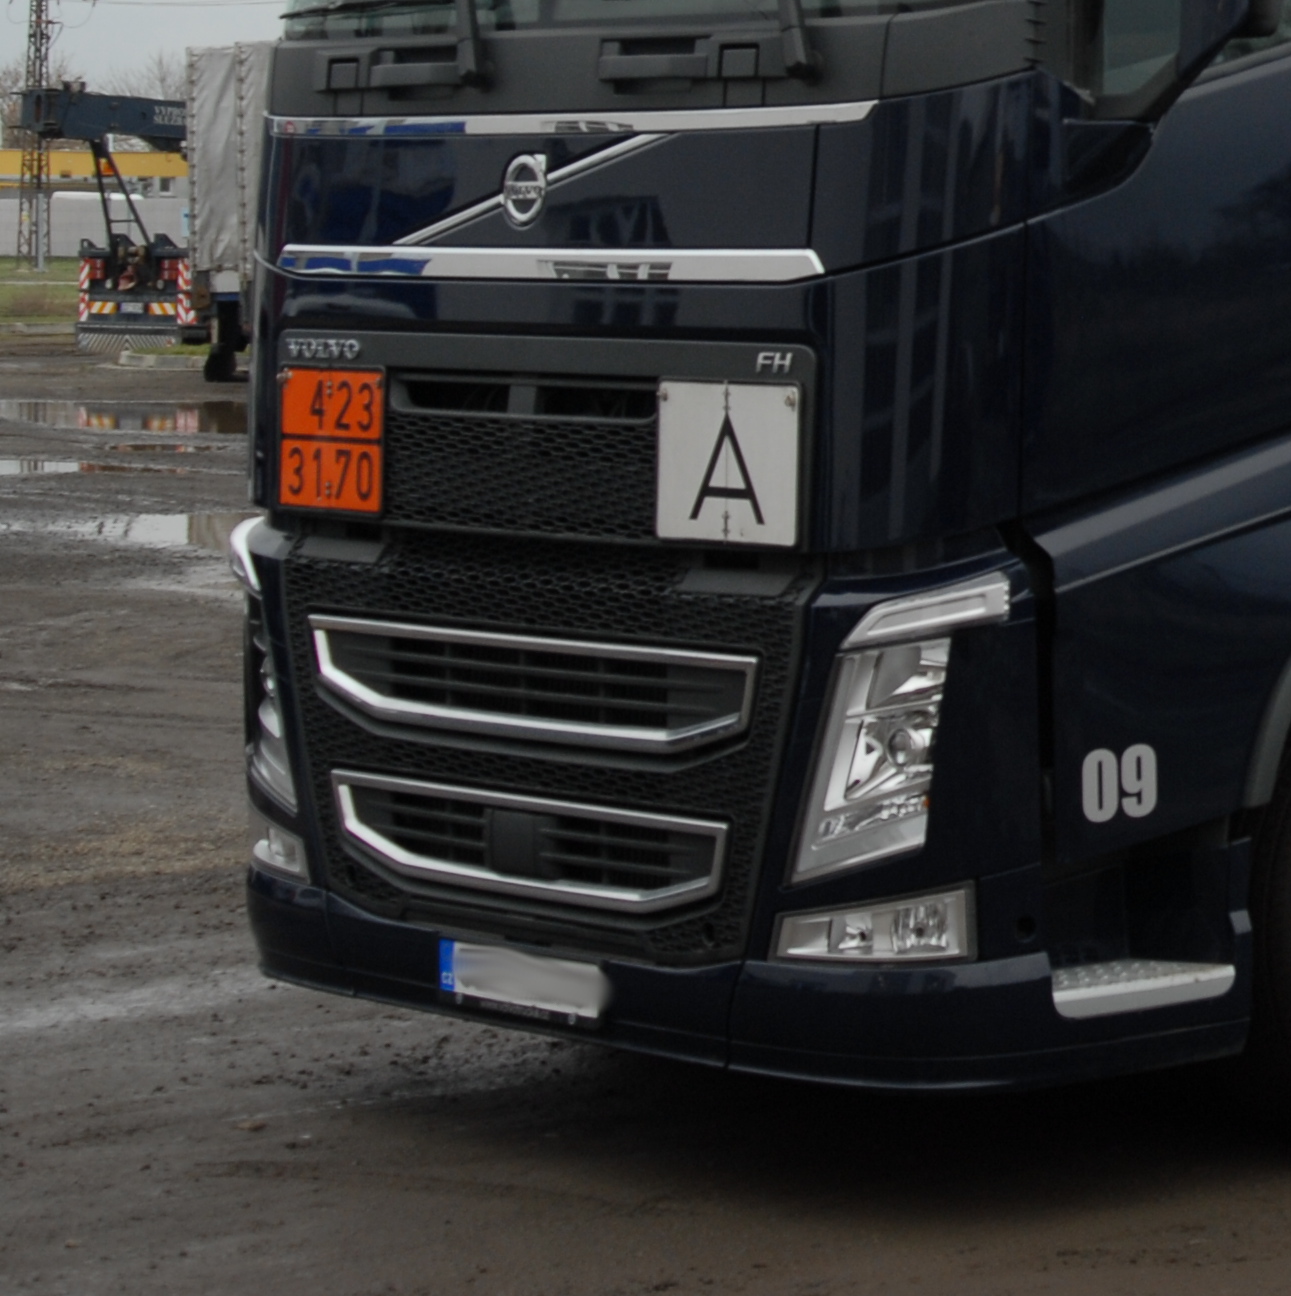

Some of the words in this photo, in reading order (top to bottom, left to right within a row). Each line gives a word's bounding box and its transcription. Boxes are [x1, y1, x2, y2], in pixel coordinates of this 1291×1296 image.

[285, 338, 361, 359] VOLVO
[755, 351, 793, 374] FH
[310, 379, 374, 433] 423
[287, 446, 374, 502] 3170
[688, 410, 766, 526] A
[1081, 743, 1158, 823] 09
